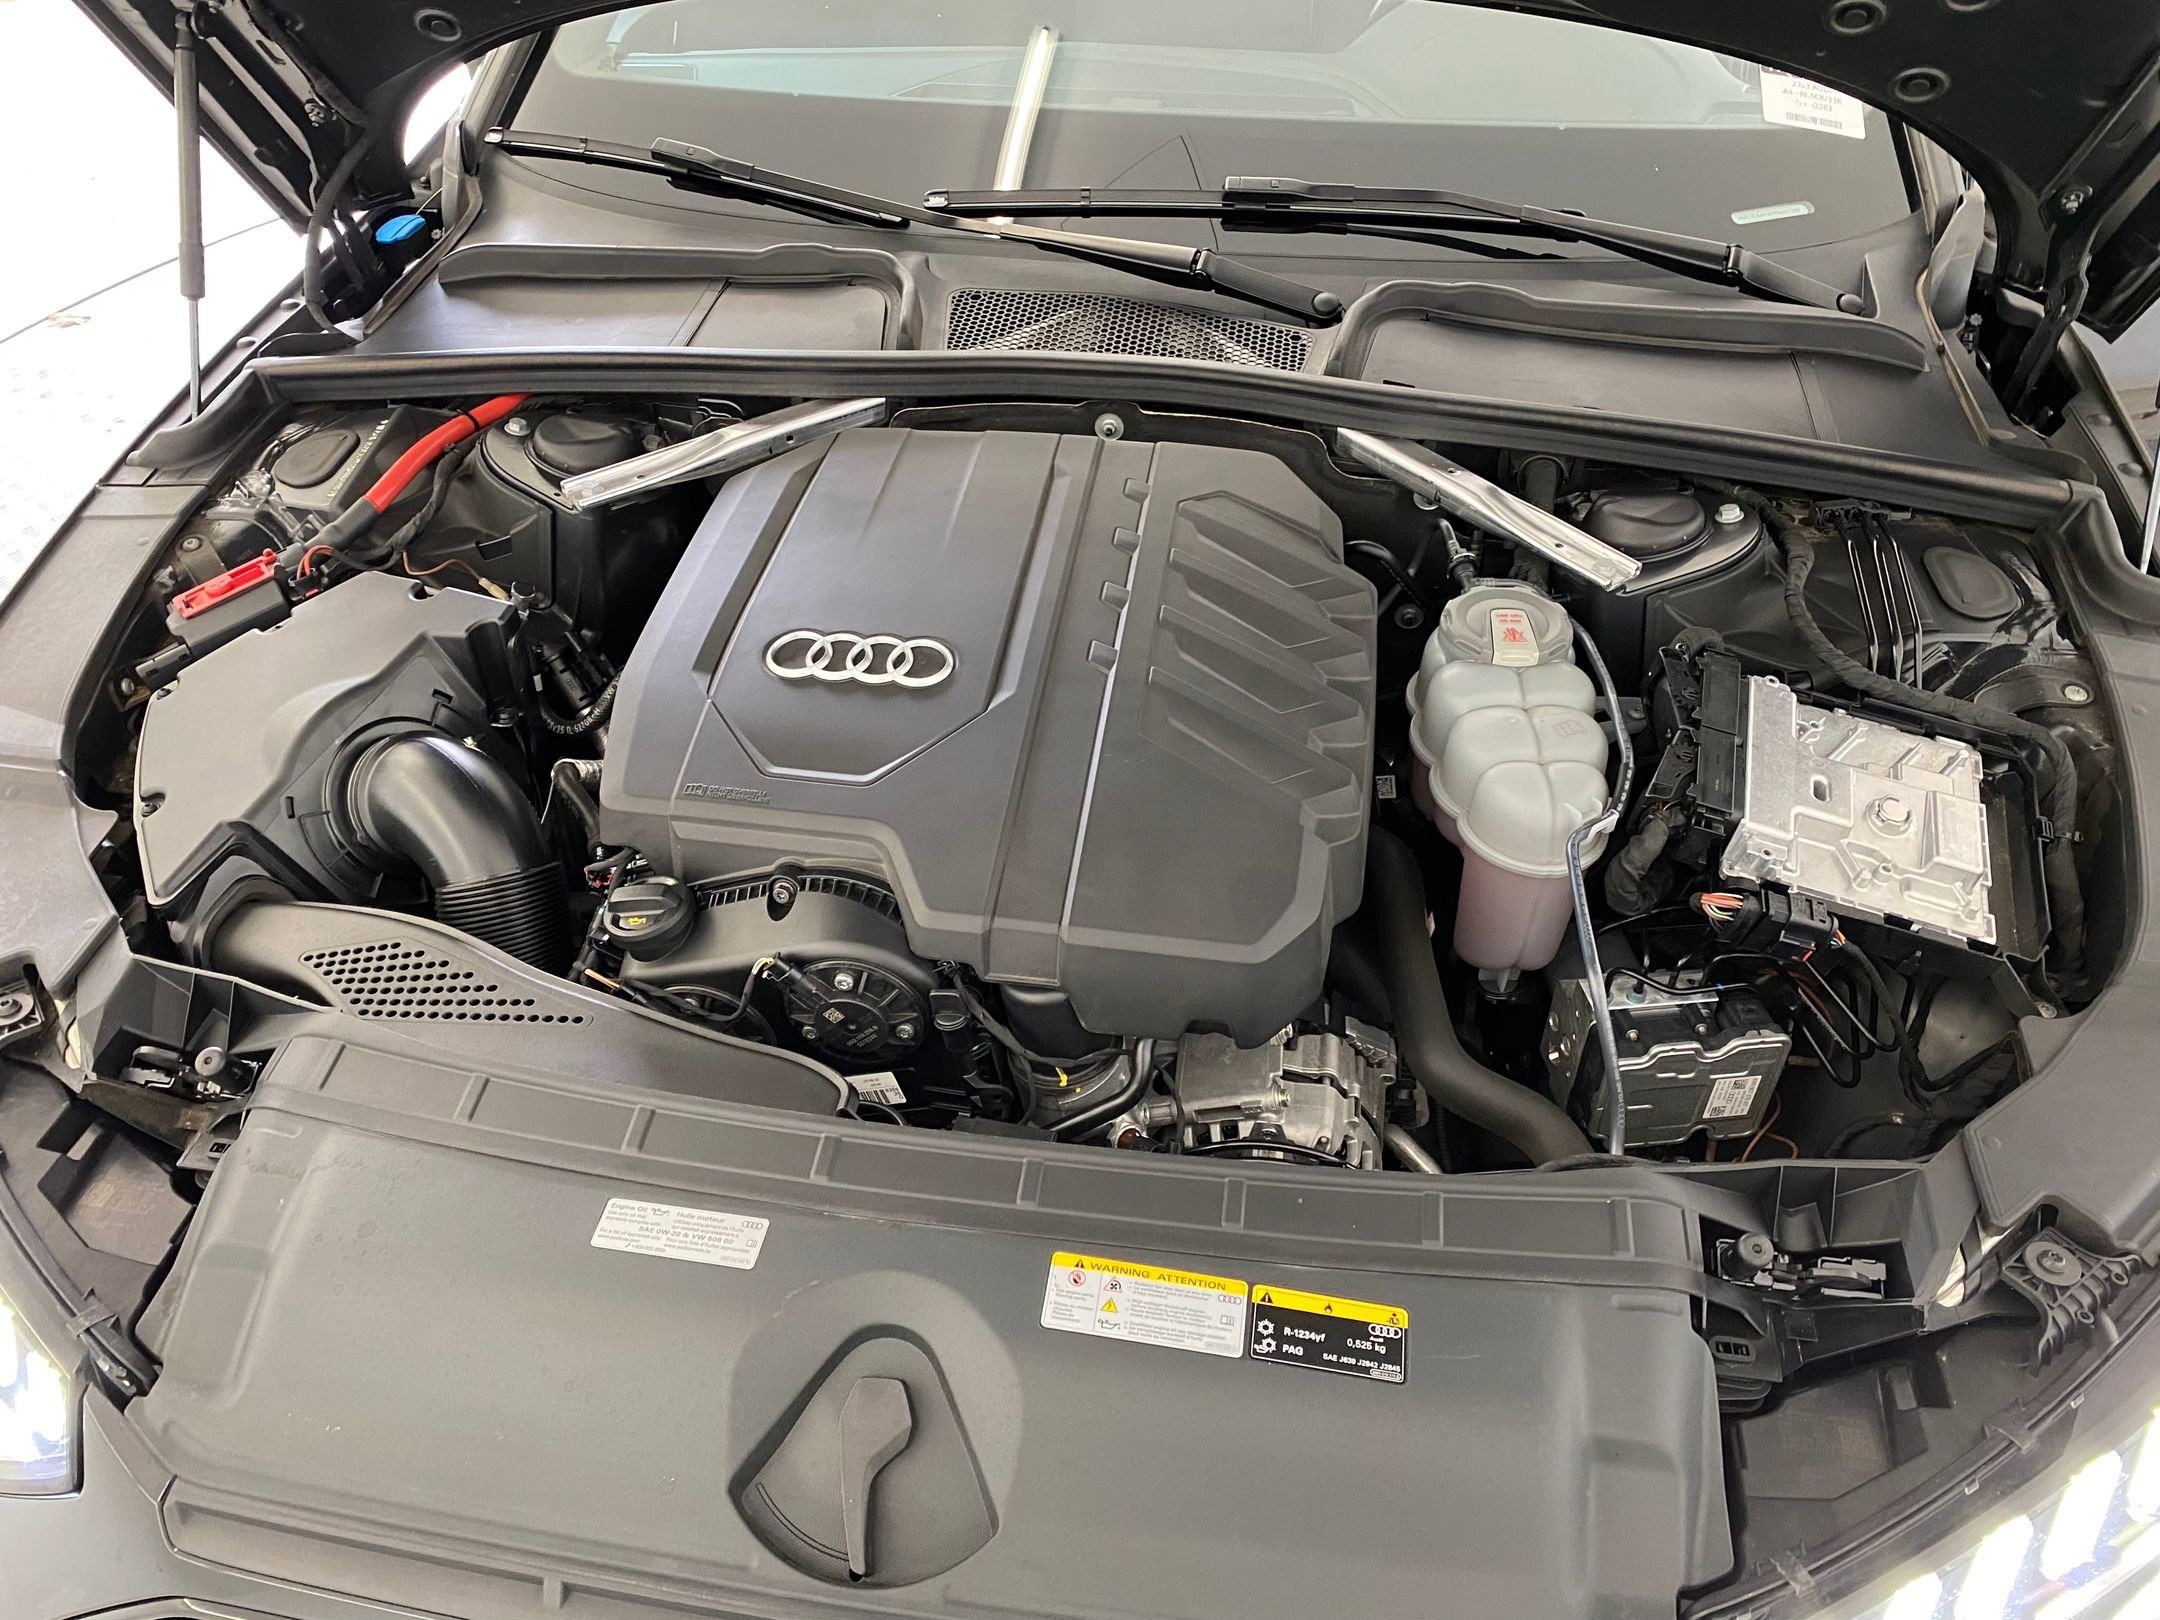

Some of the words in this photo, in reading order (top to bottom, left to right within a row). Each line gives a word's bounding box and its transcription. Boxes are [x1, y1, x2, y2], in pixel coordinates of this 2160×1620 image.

[611, 1202, 636, 1211] Engine
[677, 1211, 696, 1219] Huile
[697, 1215, 726, 1223] moteur
[638, 1225, 655, 1233] SAE
[656, 1227, 681, 1237] 0W-20
[691, 1233, 707, 1241] VW
[1089, 1261, 1150, 1280] WARNING
[1156, 1272, 1227, 1292] ATTENTION
[1283, 1326, 1326, 1344] R-1234yf
[1282, 1343, 1304, 1357] PAG
[1346, 1338, 1373, 1351] 0,525
[1374, 1343, 1387, 1355] kg
[1322, 1352, 1338, 1362] SAE
